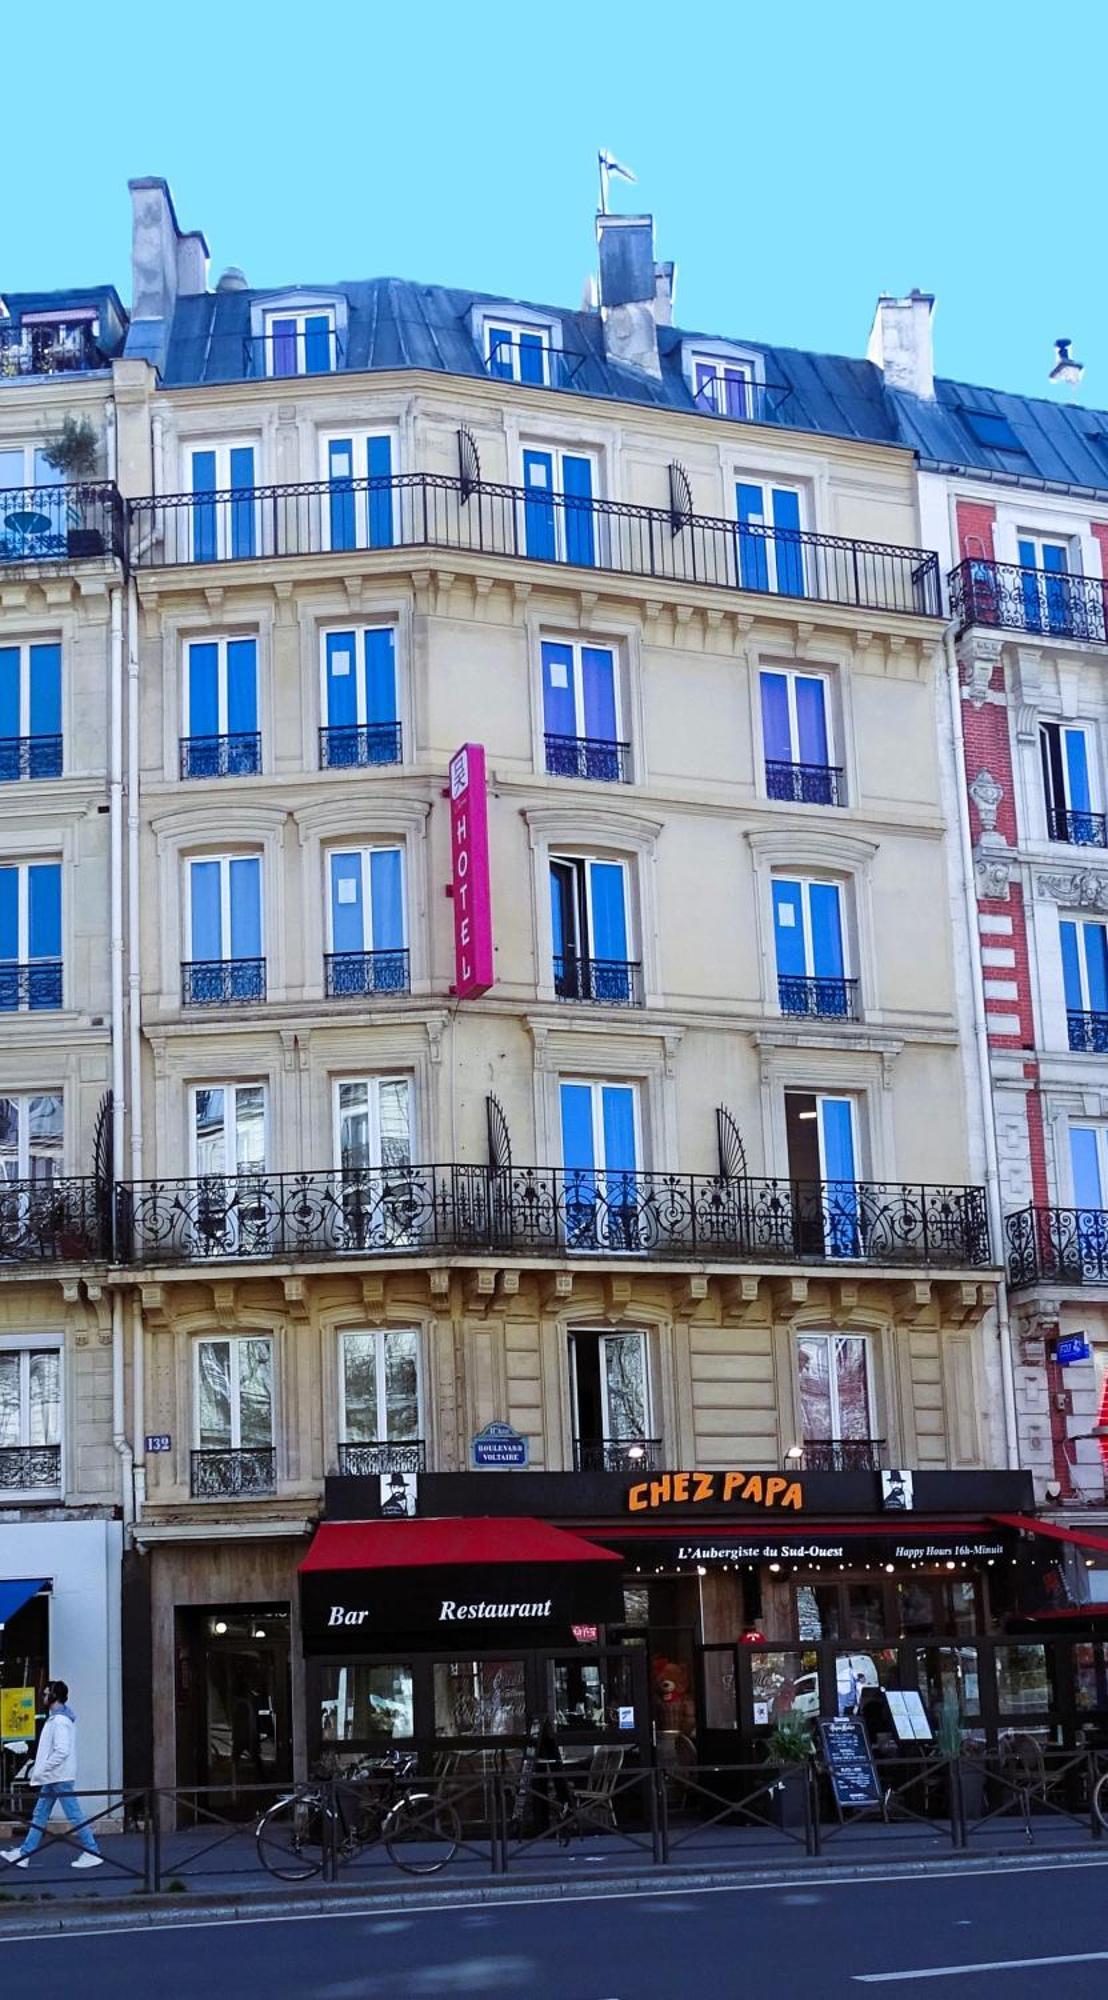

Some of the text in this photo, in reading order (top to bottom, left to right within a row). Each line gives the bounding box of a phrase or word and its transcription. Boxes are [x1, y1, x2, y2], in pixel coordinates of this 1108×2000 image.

[457, 814, 471, 980] HOTEL
[148, 1438, 169, 1450] 132
[478, 1444, 523, 1452] BOULEVARD
[628, 1471, 804, 1511] CHEZ PAPA
[678, 1545, 843, 1560] L'Aubergiste du Sud-Ouest
[895, 1544, 1004, 1559] Happy Hours 16h-Minuit
[328, 1599, 552, 1626] Bar Restaurant
